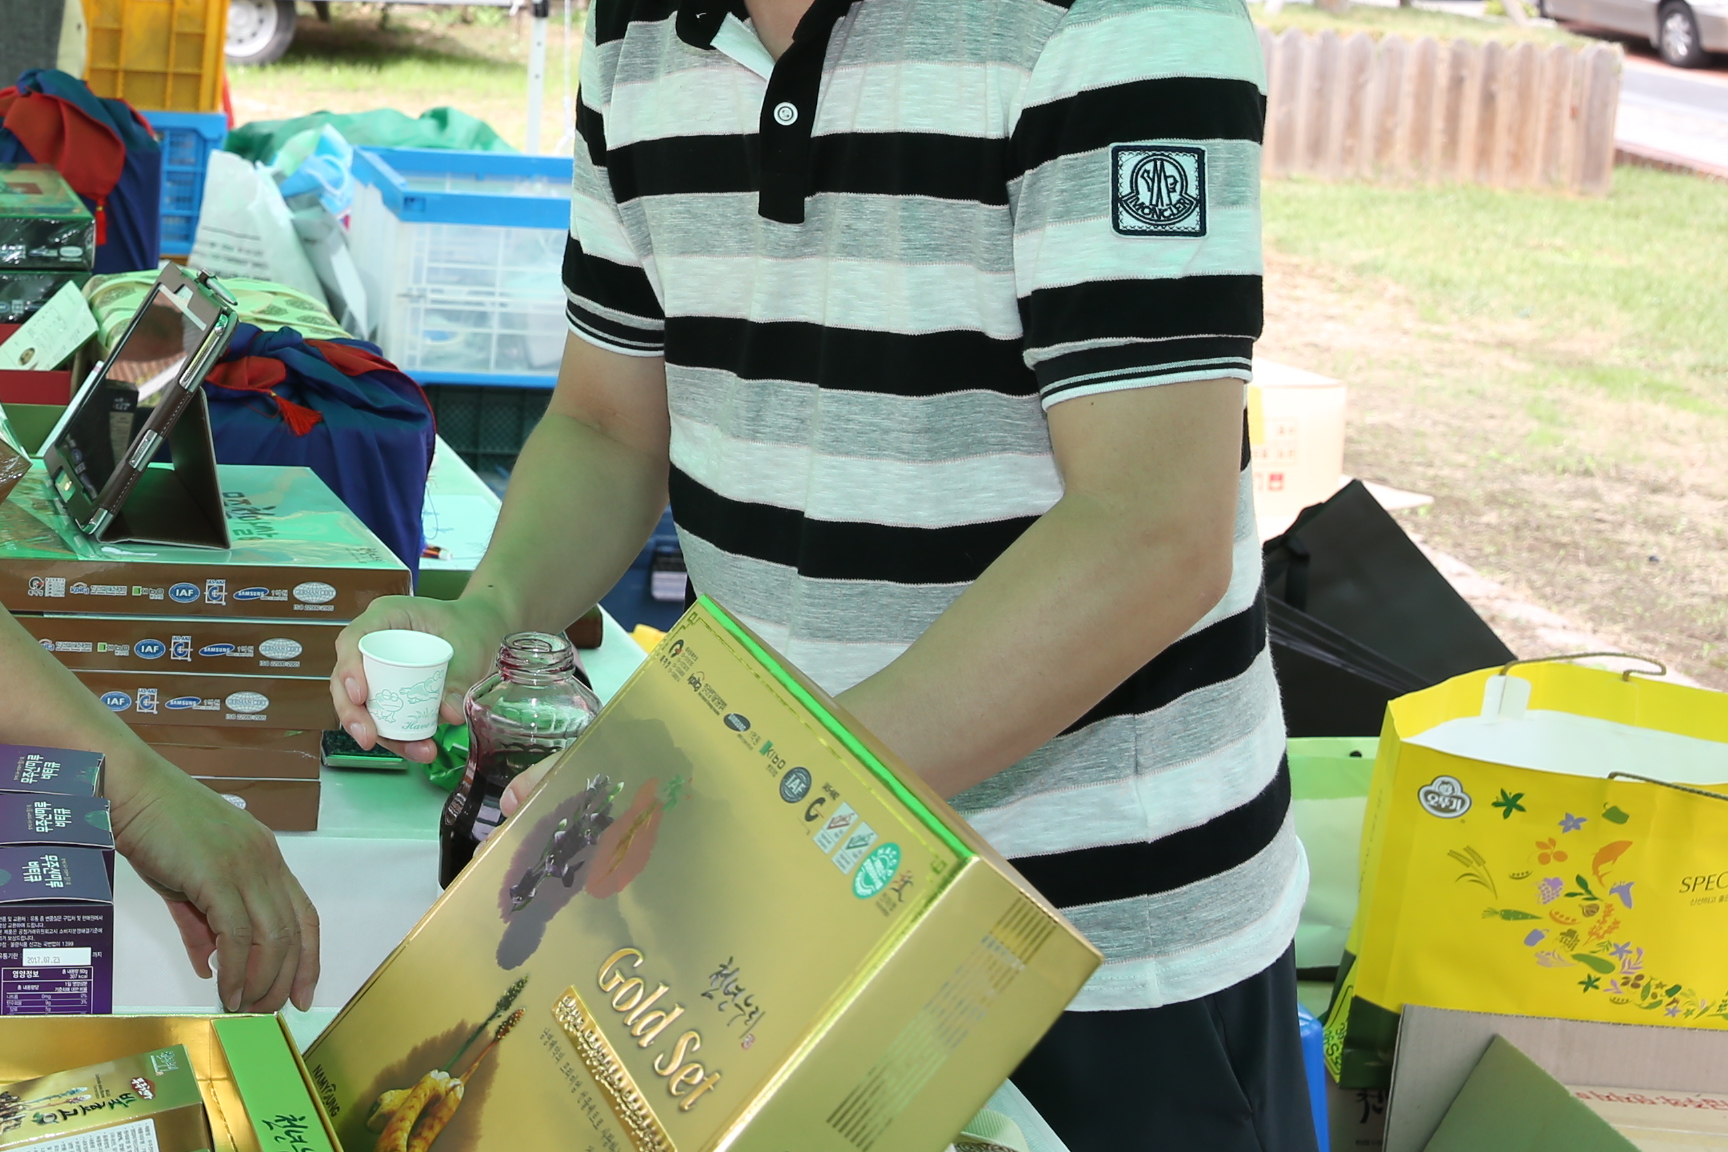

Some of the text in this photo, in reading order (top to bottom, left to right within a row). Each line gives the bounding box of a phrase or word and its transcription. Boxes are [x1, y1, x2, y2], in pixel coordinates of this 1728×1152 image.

[1129, 196, 1190, 220] MONCLER
[175, 589, 195, 597] IAF
[140, 645, 160, 654] IAF
[202, 646, 230, 654] SAMSUNG
[106, 697, 126, 706] IAF
[169, 699, 197, 707] SAMSUNG
[784, 776, 805, 794] IAF
[1427, 792, 1463, 811] 오뚜기
[27, 956, 61, 964] 2017.07.23
[12, 969, 40, 979] 영양정보
[597, 947, 686, 1049] Gold
[653, 1030, 722, 1112] Set
[312, 1063, 341, 1118] NAMYOUNG
